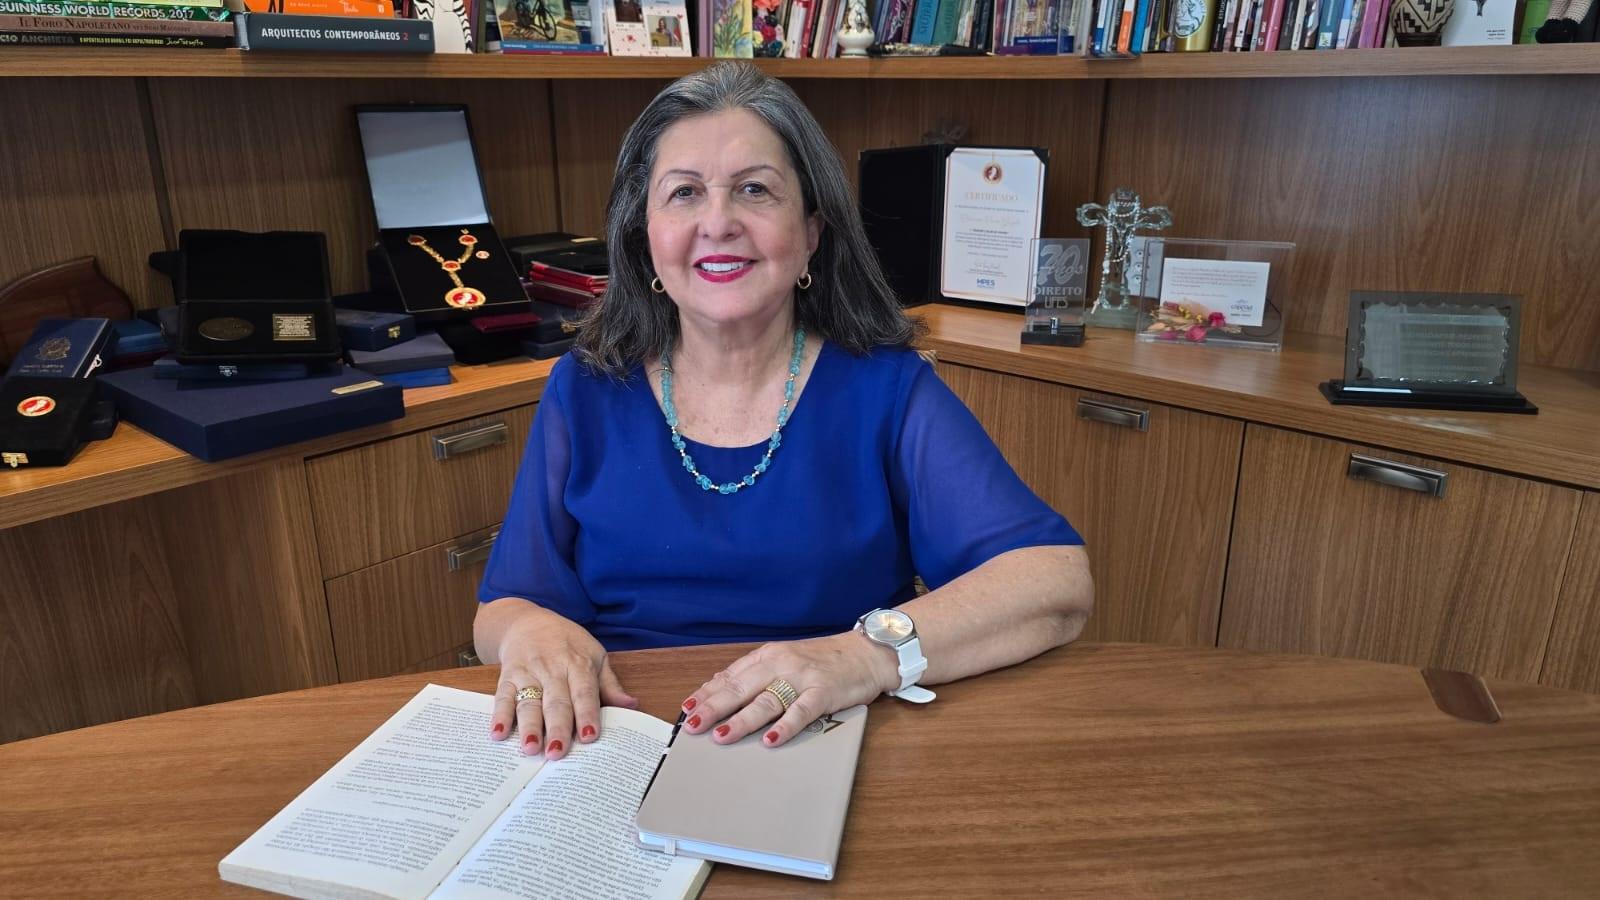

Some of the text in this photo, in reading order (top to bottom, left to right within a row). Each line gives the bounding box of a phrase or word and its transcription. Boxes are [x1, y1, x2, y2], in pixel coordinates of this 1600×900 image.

[66, 5, 110, 15] WORLD
[114, 7, 166, 18] RECORDS
[169, 10, 194, 19] 2017
[19, 17, 32, 27] IL
[33, 17, 63, 28] FORO
[65, 18, 130, 30] NAPOLETANO
[21, 35, 74, 44] ANCHIETA
[262, 28, 321, 41] ARQUITECTOS
[325, 30, 400, 41] CONTEMPORÂNEOS
[403, 32, 409, 41] 2
[1035, 286, 1083, 296] DIREITO
